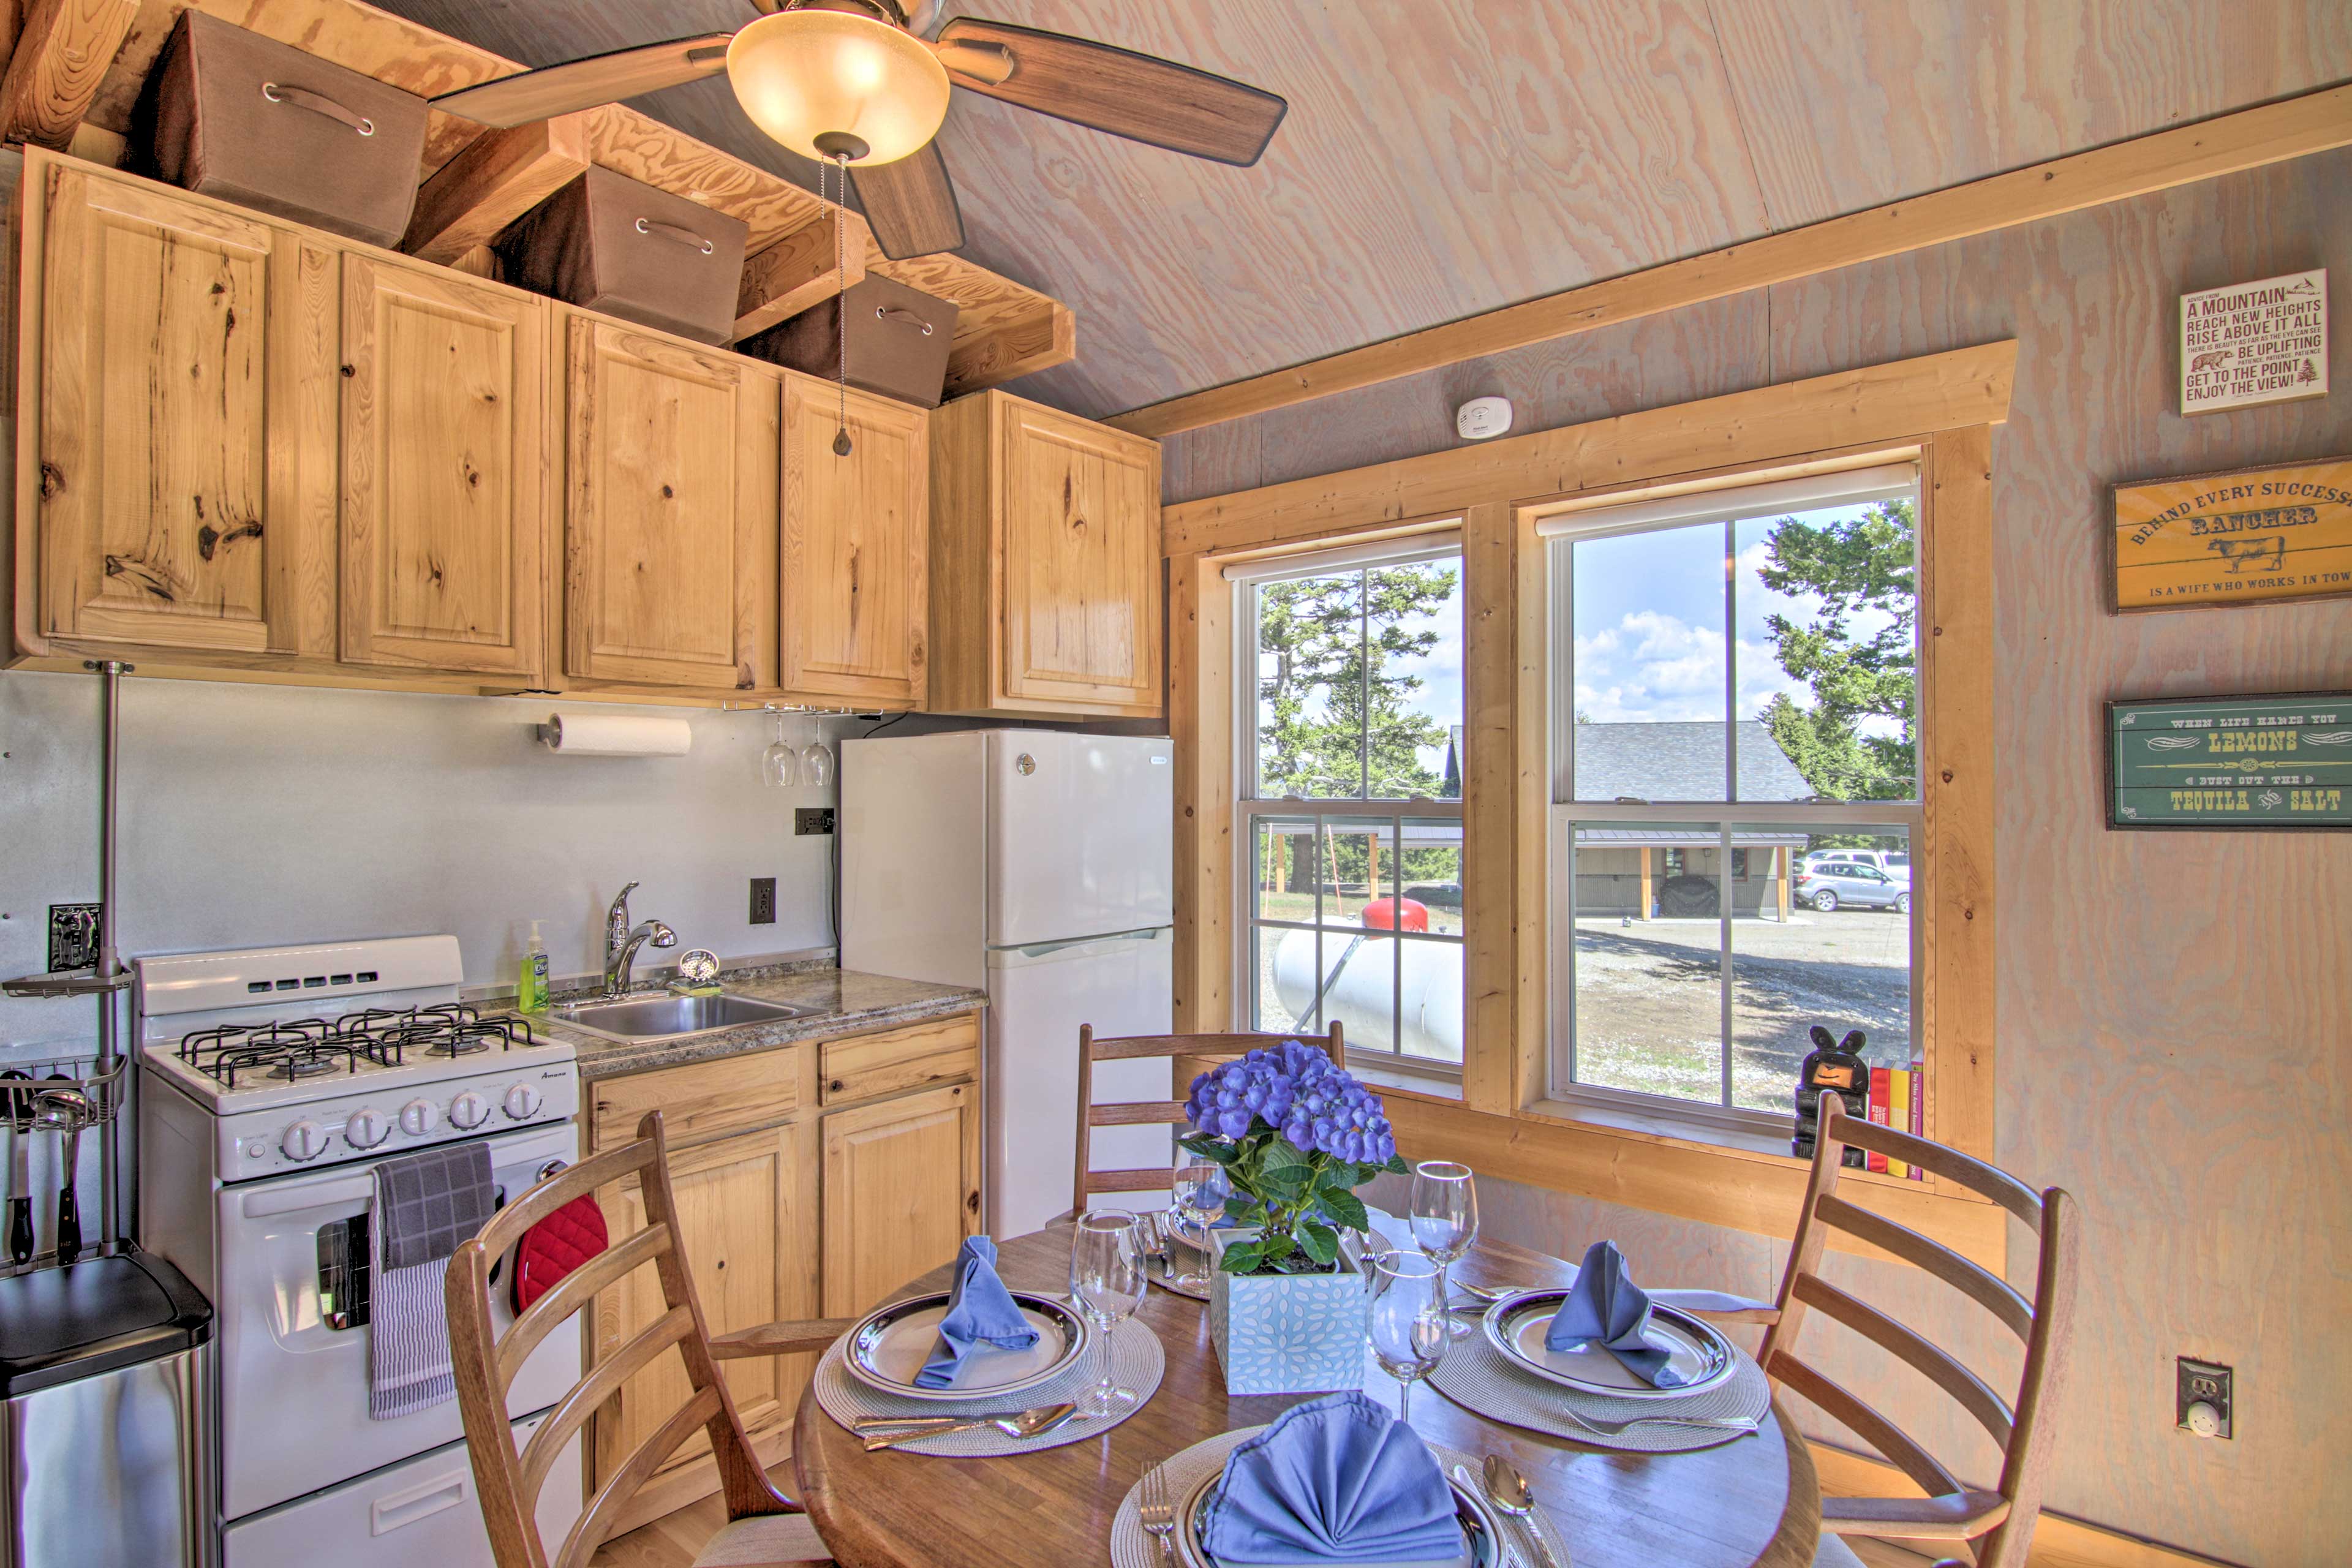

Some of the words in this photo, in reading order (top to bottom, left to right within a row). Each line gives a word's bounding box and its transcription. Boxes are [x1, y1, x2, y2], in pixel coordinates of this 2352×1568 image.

[2187, 303, 2197, 318] A
[2202, 287, 2284, 315] MOUNTAIN
[2187, 317, 2226, 332] REACH
[2233, 310, 2260, 325] NEW
[2266, 300, 2321, 318] HEIGHTS
[2187, 330, 2218, 346] RISE
[2224, 321, 2269, 340] ABOVE
[2275, 318, 2288, 330] IT
[2294, 313, 2321, 328] ALL
[2215, 341, 2237, 349] BEAUTY
[2238, 346, 2253, 358] BE
[2258, 335, 2321, 356] UPLIFTING
[2295, 348, 2321, 356] PATIENCE
[2187, 373, 2209, 387] GET
[2215, 370, 2229, 382] TO
[2233, 366, 2256, 380] THE
[2261, 358, 2300, 376] POINT
[2187, 385, 2226, 401] ENJOY
[2230, 380, 2253, 394] THE
[2257, 374, 2293, 391] VIEW!
[2130, 502, 2191, 546] BEHIND
[2196, 484, 2254, 508] EVERY
[2261, 483, 2352, 508] SUCCESS
[2189, 507, 2318, 537] RANCHER
[2150, 588, 2162, 597] IS
[2166, 587, 2173, 595] A
[2178, 584, 2209, 594] WIFE
[2212, 581, 2242, 591] WHO
[2248, 576, 2295, 589] WORKS
[2303, 575, 2317, 584] IN
[2171, 719, 2212, 728] WHEN
[2220, 718, 2249, 726] LIFE
[2311, 715, 2337, 723] YOU
[2208, 730, 2297, 753] LEMONS
[2239, 776, 2264, 785] OUT
[2171, 790, 2249, 812] TEQUILA
[2290, 790, 2341, 810] SALT
